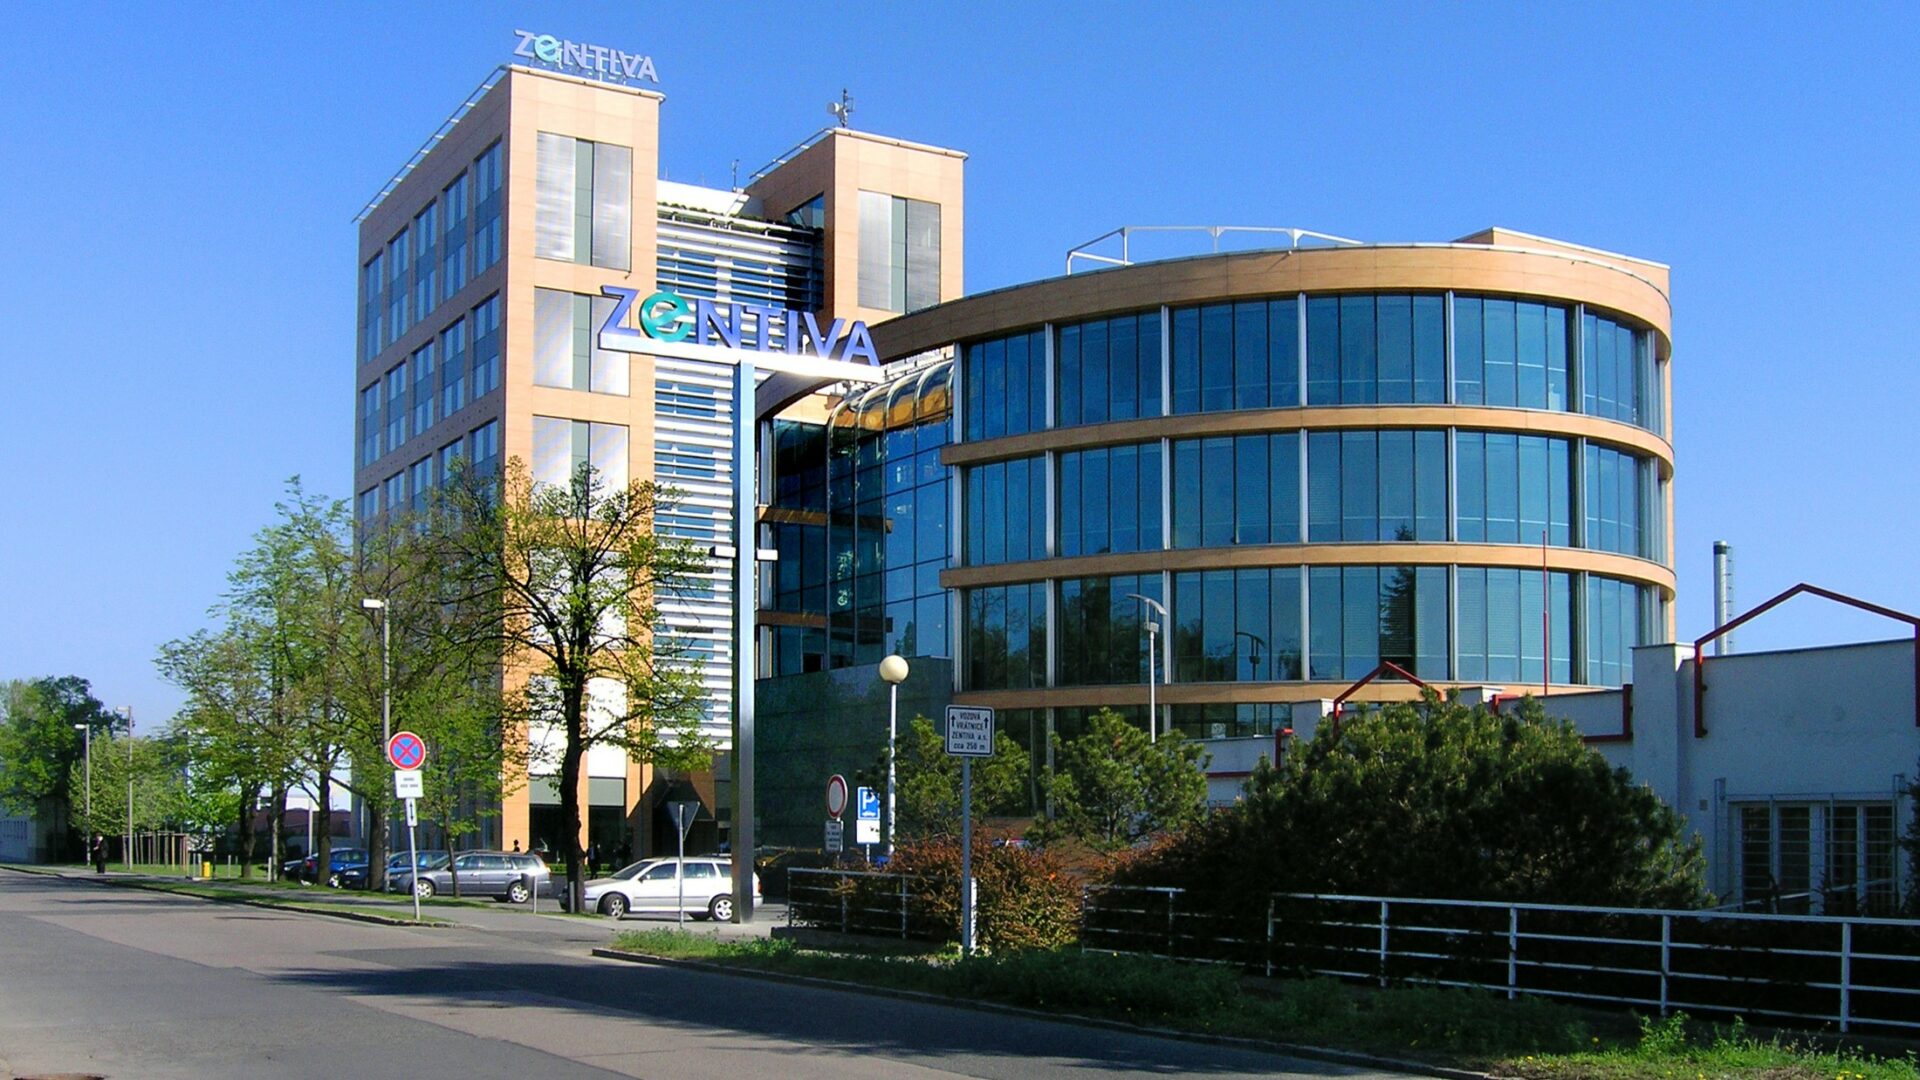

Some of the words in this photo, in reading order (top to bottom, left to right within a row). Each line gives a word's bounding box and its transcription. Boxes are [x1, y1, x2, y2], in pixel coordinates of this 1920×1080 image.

[956, 721, 983, 731] VRÁTNICE
[952, 731, 975, 739] ZENTIVA
[966, 742, 978, 750] 250
[862, 790, 876, 810] P
